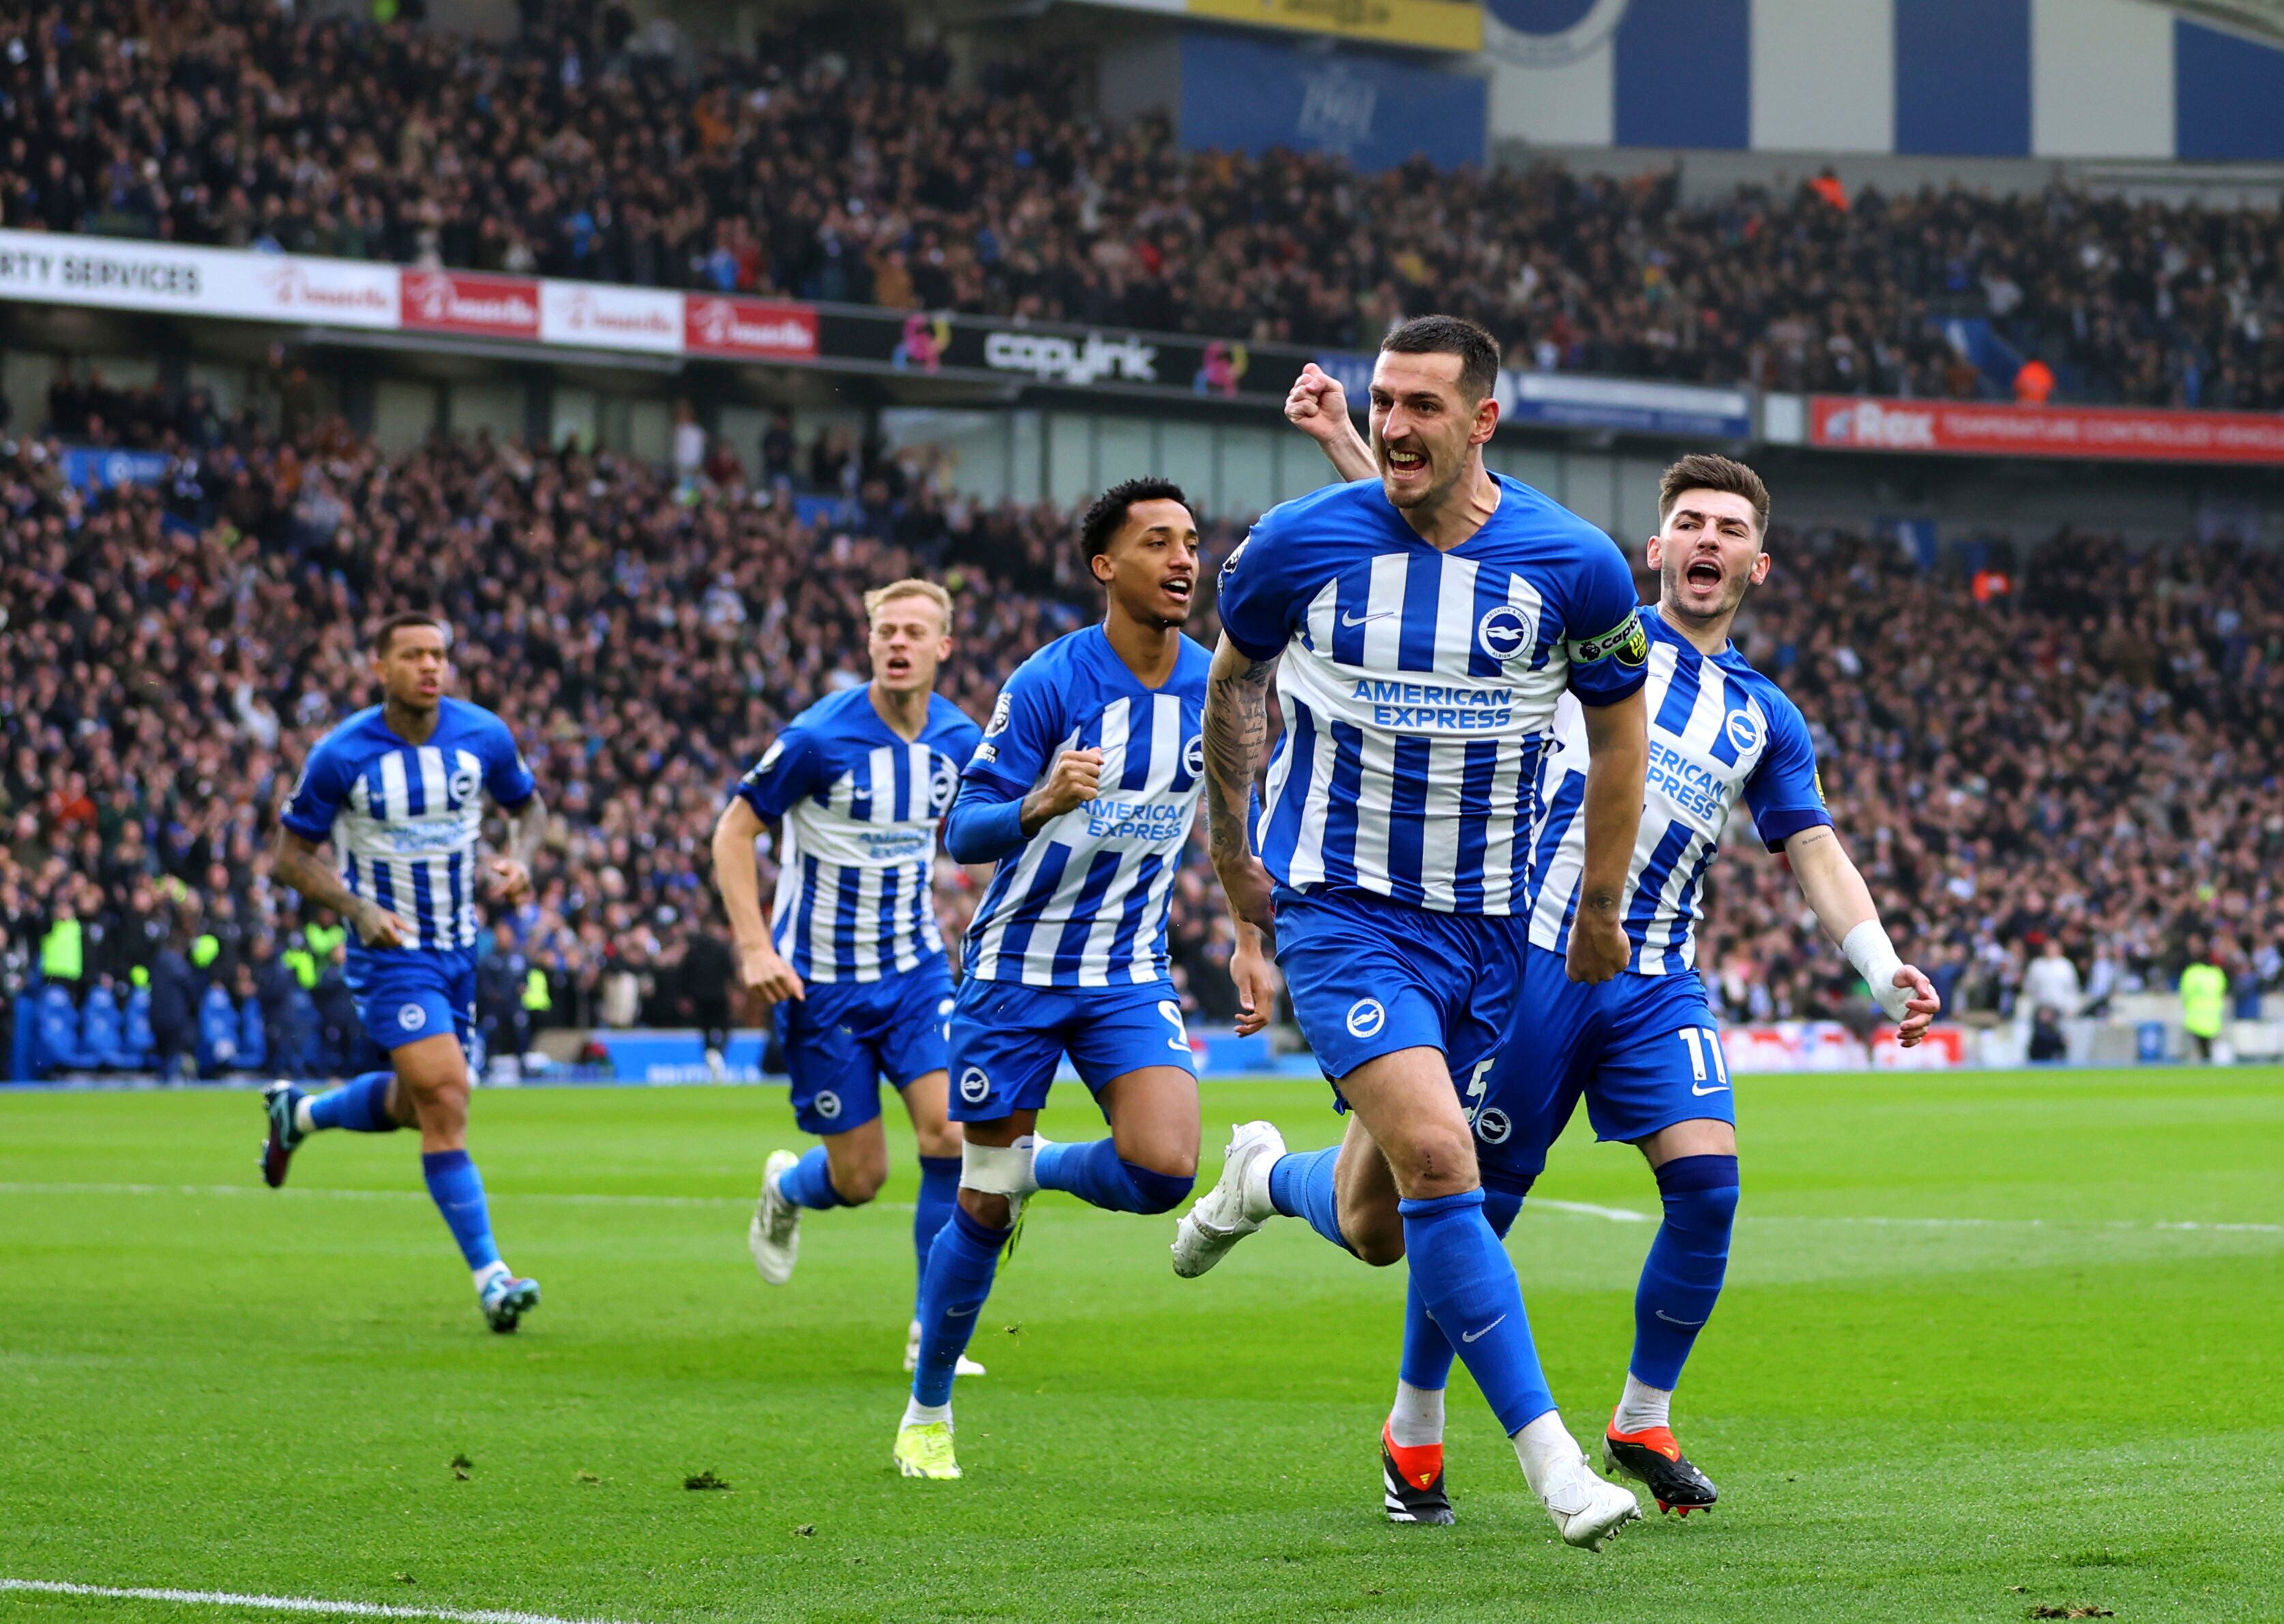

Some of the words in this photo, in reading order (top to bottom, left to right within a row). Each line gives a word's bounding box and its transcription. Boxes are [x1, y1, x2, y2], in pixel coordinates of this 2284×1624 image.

[65, 255, 201, 296] SERVICES
[1487, 608, 1511, 620] BRIGHTON
[1517, 612, 1527, 625] HOVE
[1351, 679, 1513, 707] AMERICAN
[1374, 705, 1513, 729] EXPRESS
[1649, 740, 1727, 803] ERICAN
[1645, 766, 1717, 821] PRESS
[1087, 818, 1182, 841] EXPRESS
[1679, 1027, 1727, 1084] 11
[1462, 1057, 1495, 1123] 5
